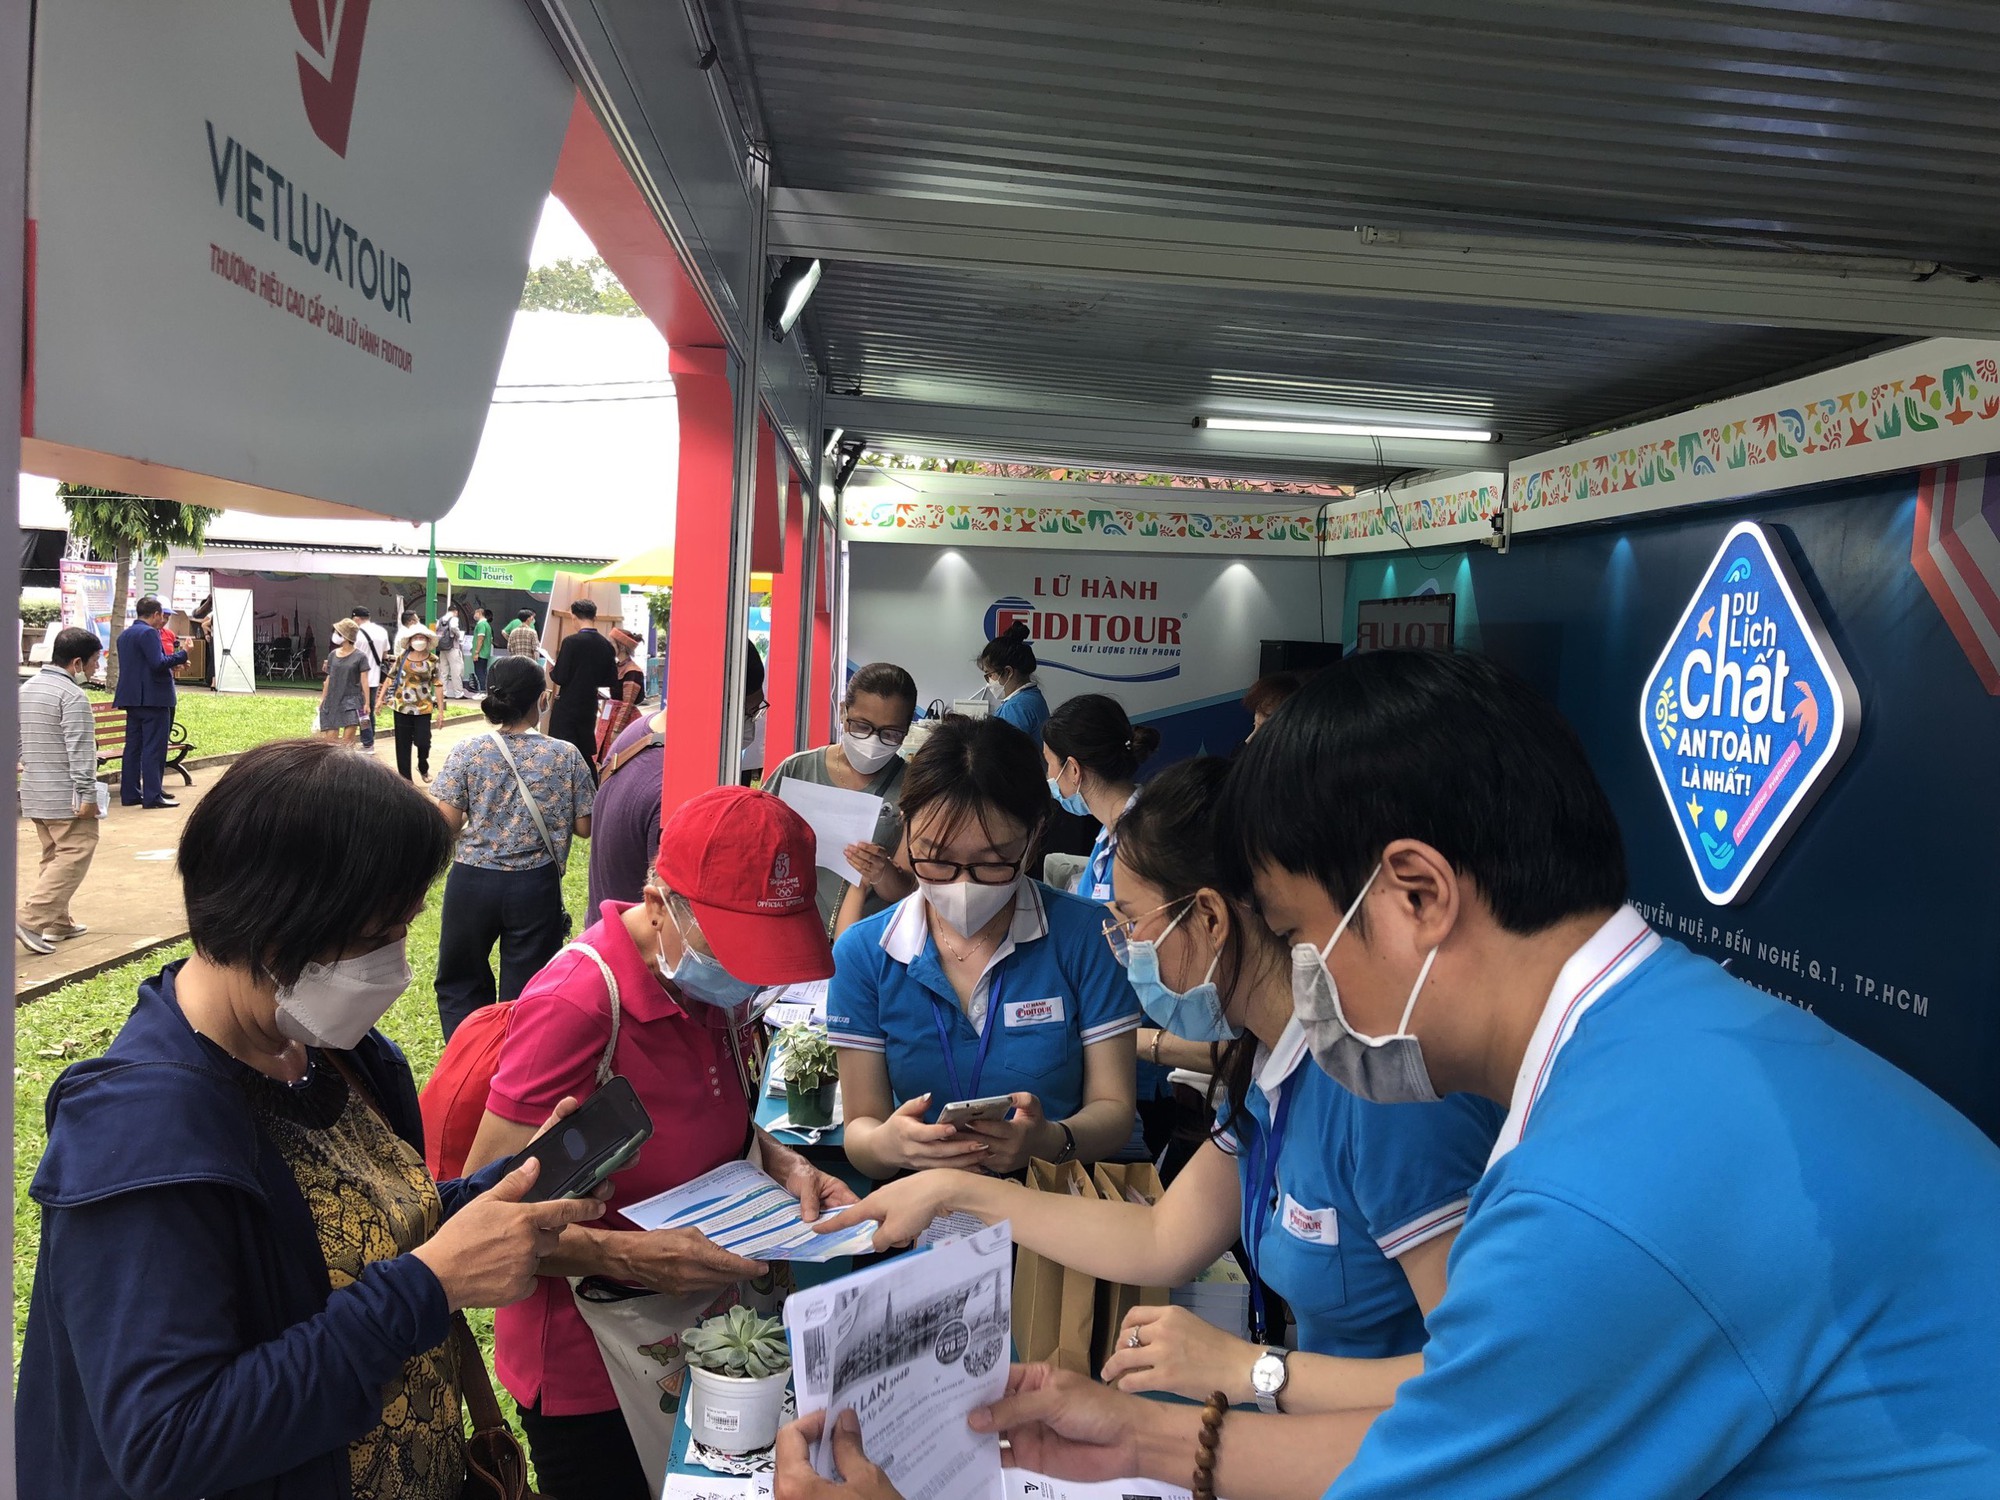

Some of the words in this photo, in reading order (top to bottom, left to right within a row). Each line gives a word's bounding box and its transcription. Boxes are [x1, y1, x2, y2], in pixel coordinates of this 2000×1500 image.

[205, 119, 412, 324] VIETLUXTOUR
[209, 242, 257, 294] THƯƠNG
[259, 270, 284, 308] HIỆU
[286, 292, 305, 319] CAO
[307, 293, 326, 328] CẤP
[381, 338, 413, 374] FIDITOUR
[482, 572, 513, 581] Tourist
[1034, 574, 1071, 597] LỮ
[1081, 576, 1158, 600] HÀNH
[1732, 591, 1759, 616] DU
[1071, 643, 1094, 654] CHẤT
[1152, 649, 1181, 657] PHONG
[1730, 616, 1777, 655] Lịch
[1680, 594, 1790, 724] Chất
[1677, 728, 1707, 759] AN
[1709, 725, 1771, 765] TOÀN
[1855, 974, 1929, 1018] TP.HCM
